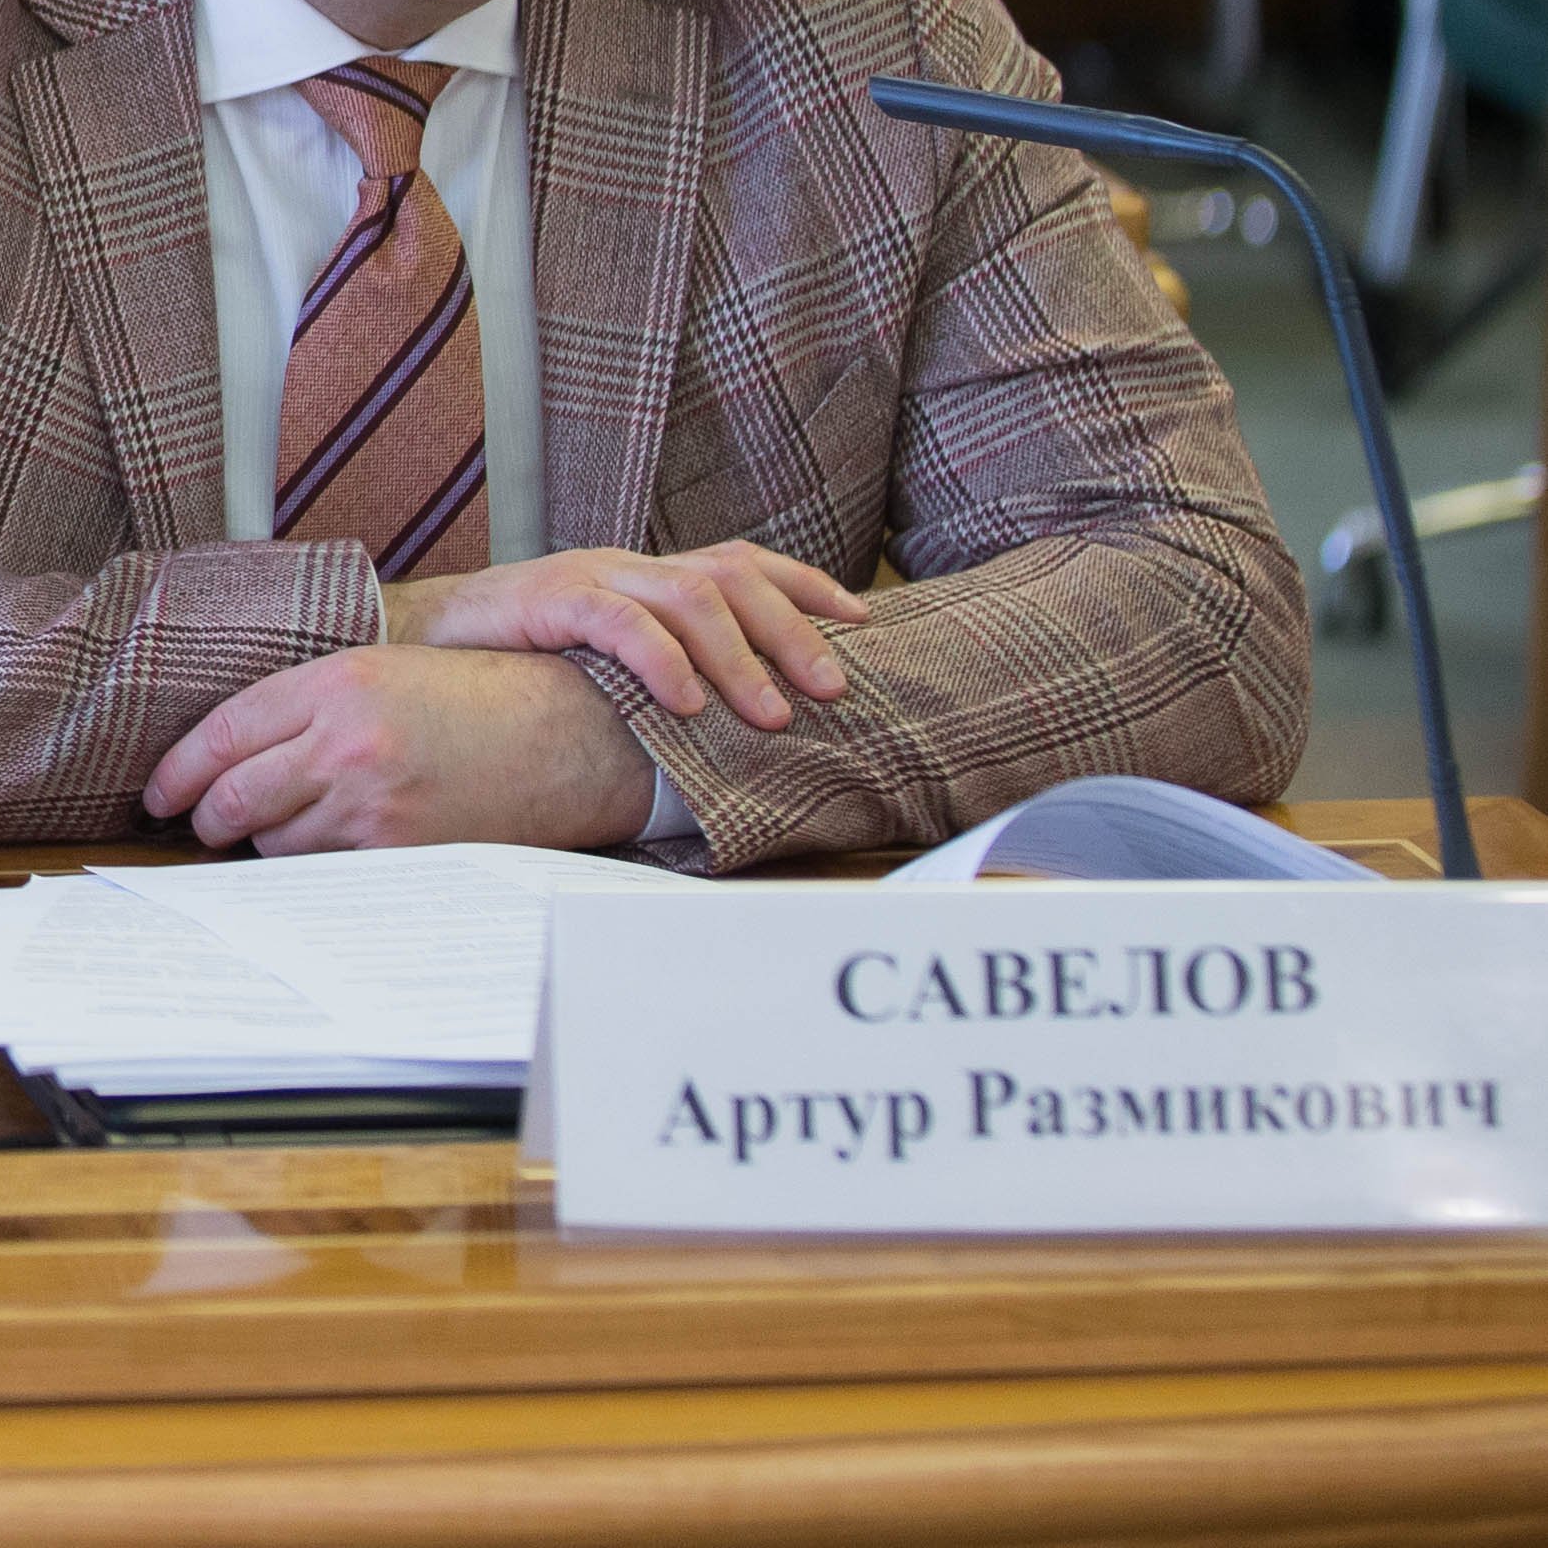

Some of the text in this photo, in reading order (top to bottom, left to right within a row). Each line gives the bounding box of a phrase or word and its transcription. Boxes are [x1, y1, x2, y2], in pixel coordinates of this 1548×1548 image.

[832, 944, 1320, 1025] САВЕЛОВ
[660, 1068, 1502, 1165] Артур Размикович
